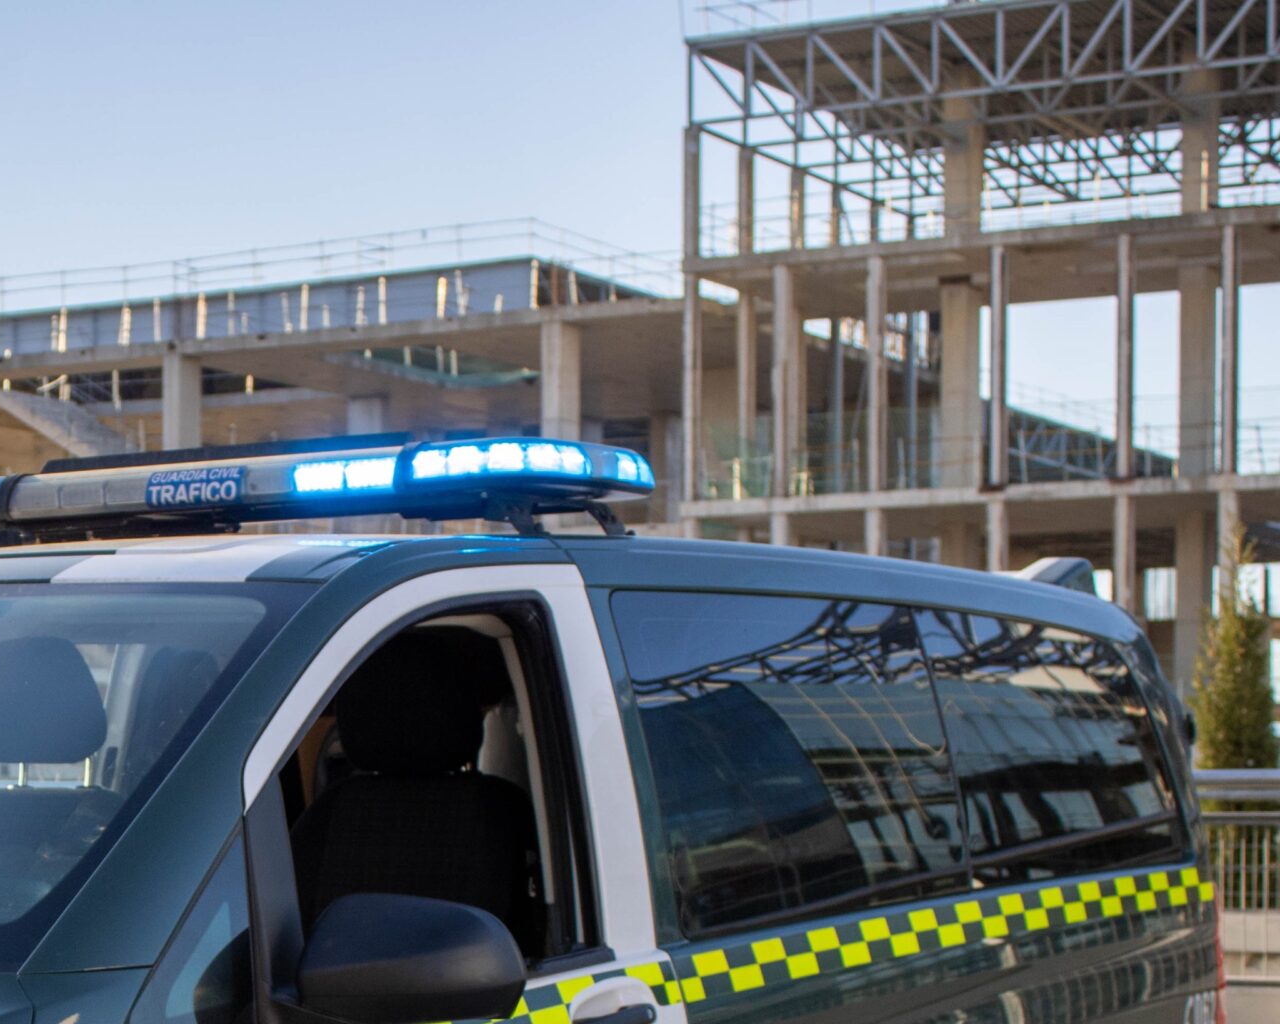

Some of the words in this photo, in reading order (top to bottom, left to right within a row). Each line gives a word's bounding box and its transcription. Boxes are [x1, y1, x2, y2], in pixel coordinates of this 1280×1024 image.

[151, 469, 207, 484] GUARDIA
[209, 466, 241, 480] CIVIL
[148, 480, 237, 506] TRAFICO
